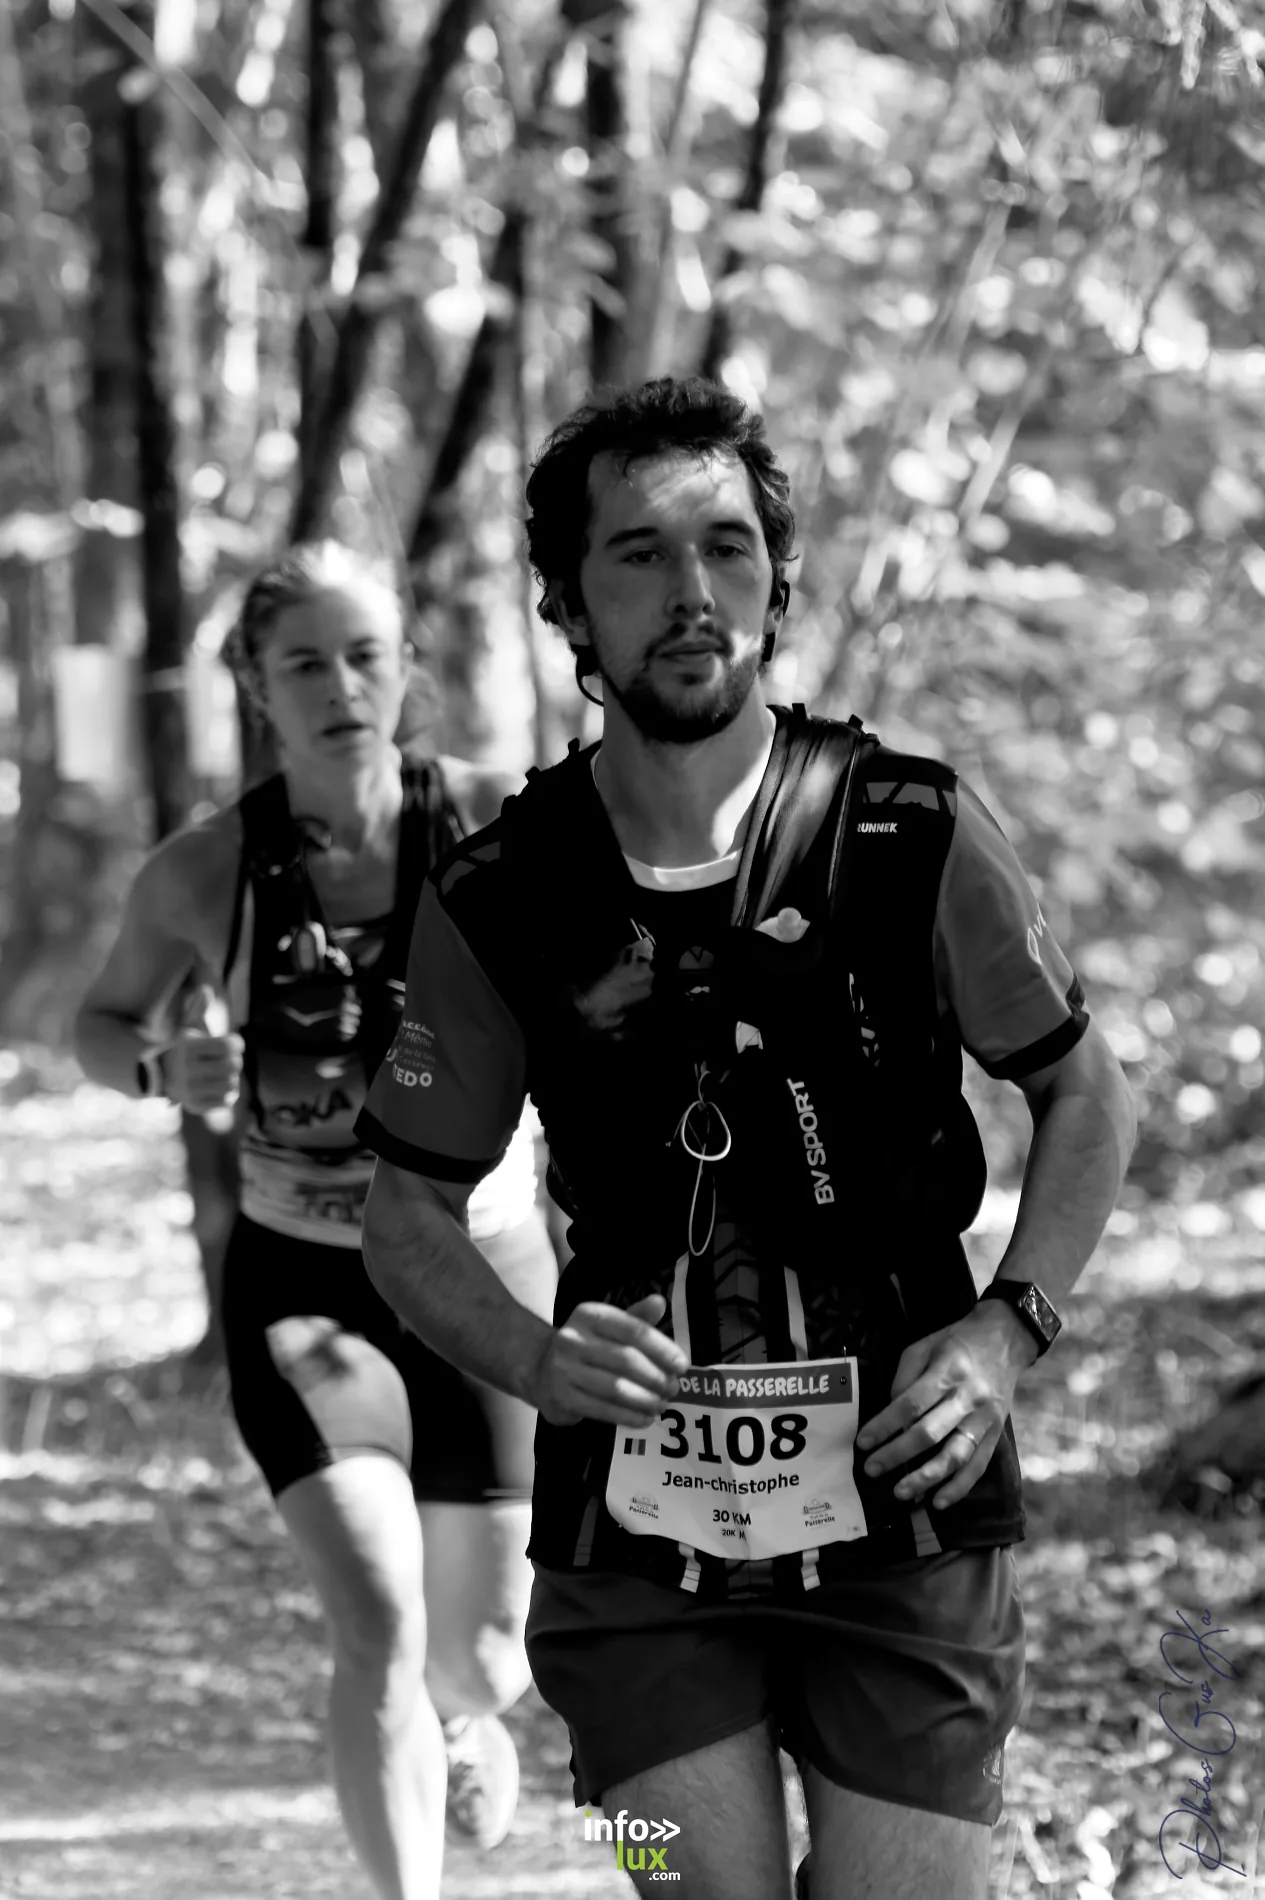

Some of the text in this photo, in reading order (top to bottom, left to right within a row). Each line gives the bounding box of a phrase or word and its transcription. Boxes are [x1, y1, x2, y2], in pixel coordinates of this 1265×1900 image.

[787, 1078, 835, 1205] BV SPORT
[679, 1374, 830, 1397] DE LA PASSERELLE
[660, 1408, 808, 1466] 3108
[662, 1471, 800, 1495] Jean-christophe
[712, 1509, 752, 1526] 30 KM
